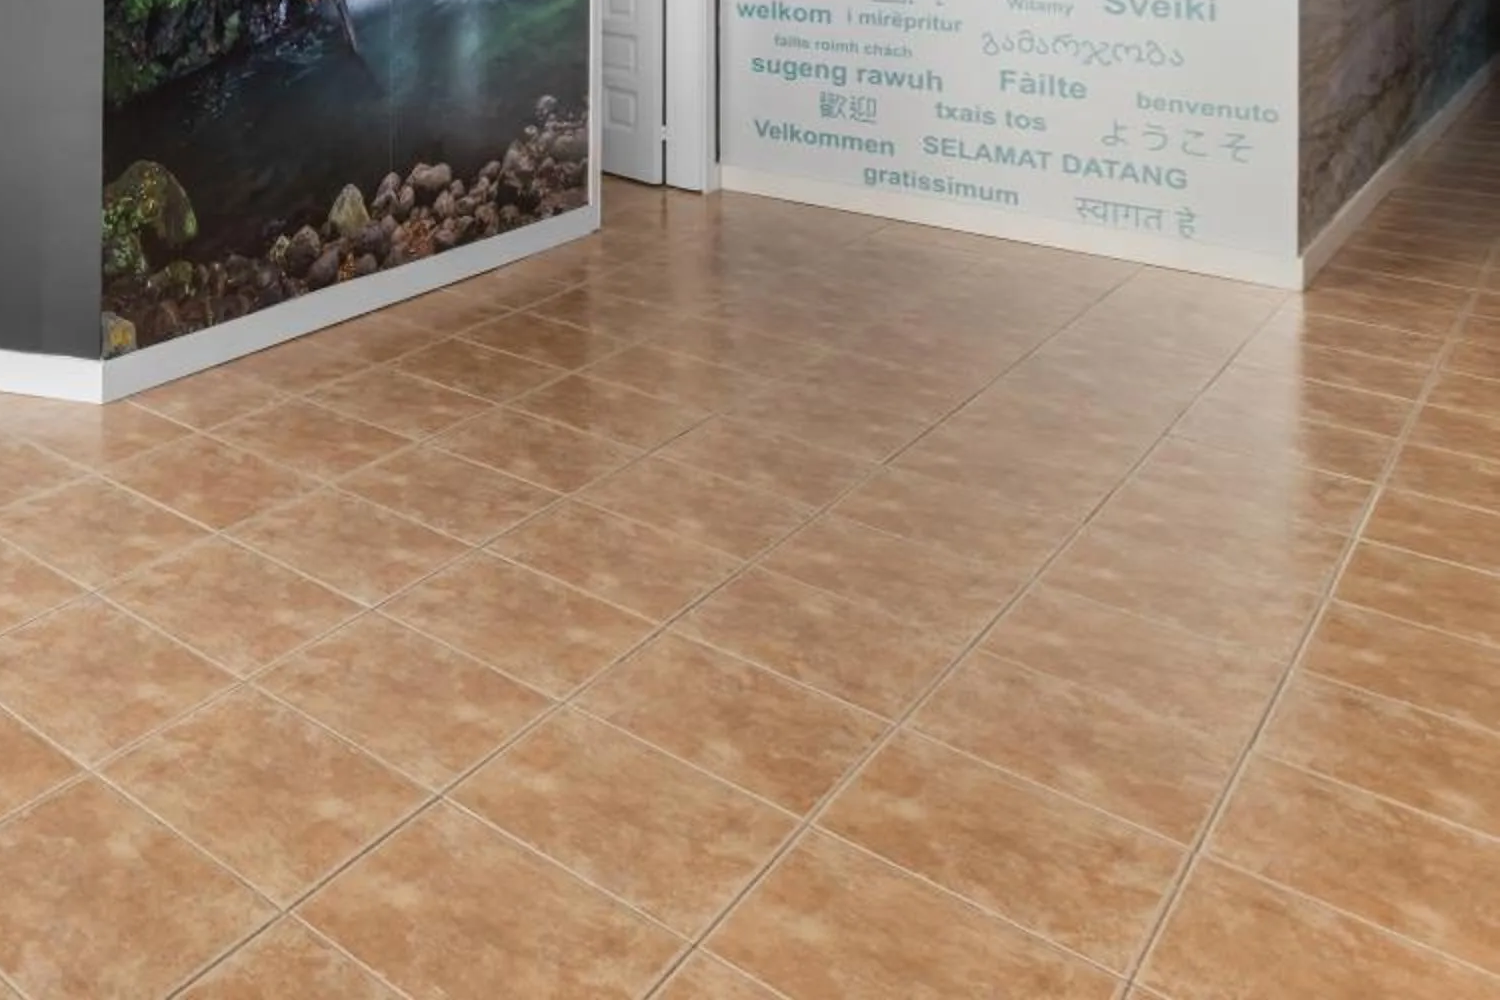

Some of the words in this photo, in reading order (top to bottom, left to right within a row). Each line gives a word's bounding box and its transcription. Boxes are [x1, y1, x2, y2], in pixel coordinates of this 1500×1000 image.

[736, 0, 832, 25] welkom
[751, 57, 847, 86] sugeng
[856, 67, 944, 93] rawuh
[934, 102, 997, 126] txais
[1005, 110, 1047, 132] tos
[1136, 91, 1280, 124] benvenuto
[754, 118, 896, 157] Velkommen
[1101, 117, 1255, 164] ようこそ
[922, 135, 1053, 170] SELAMAT
[1061, 153, 1189, 190] DATANG
[863, 167, 1020, 206] gratissimum
